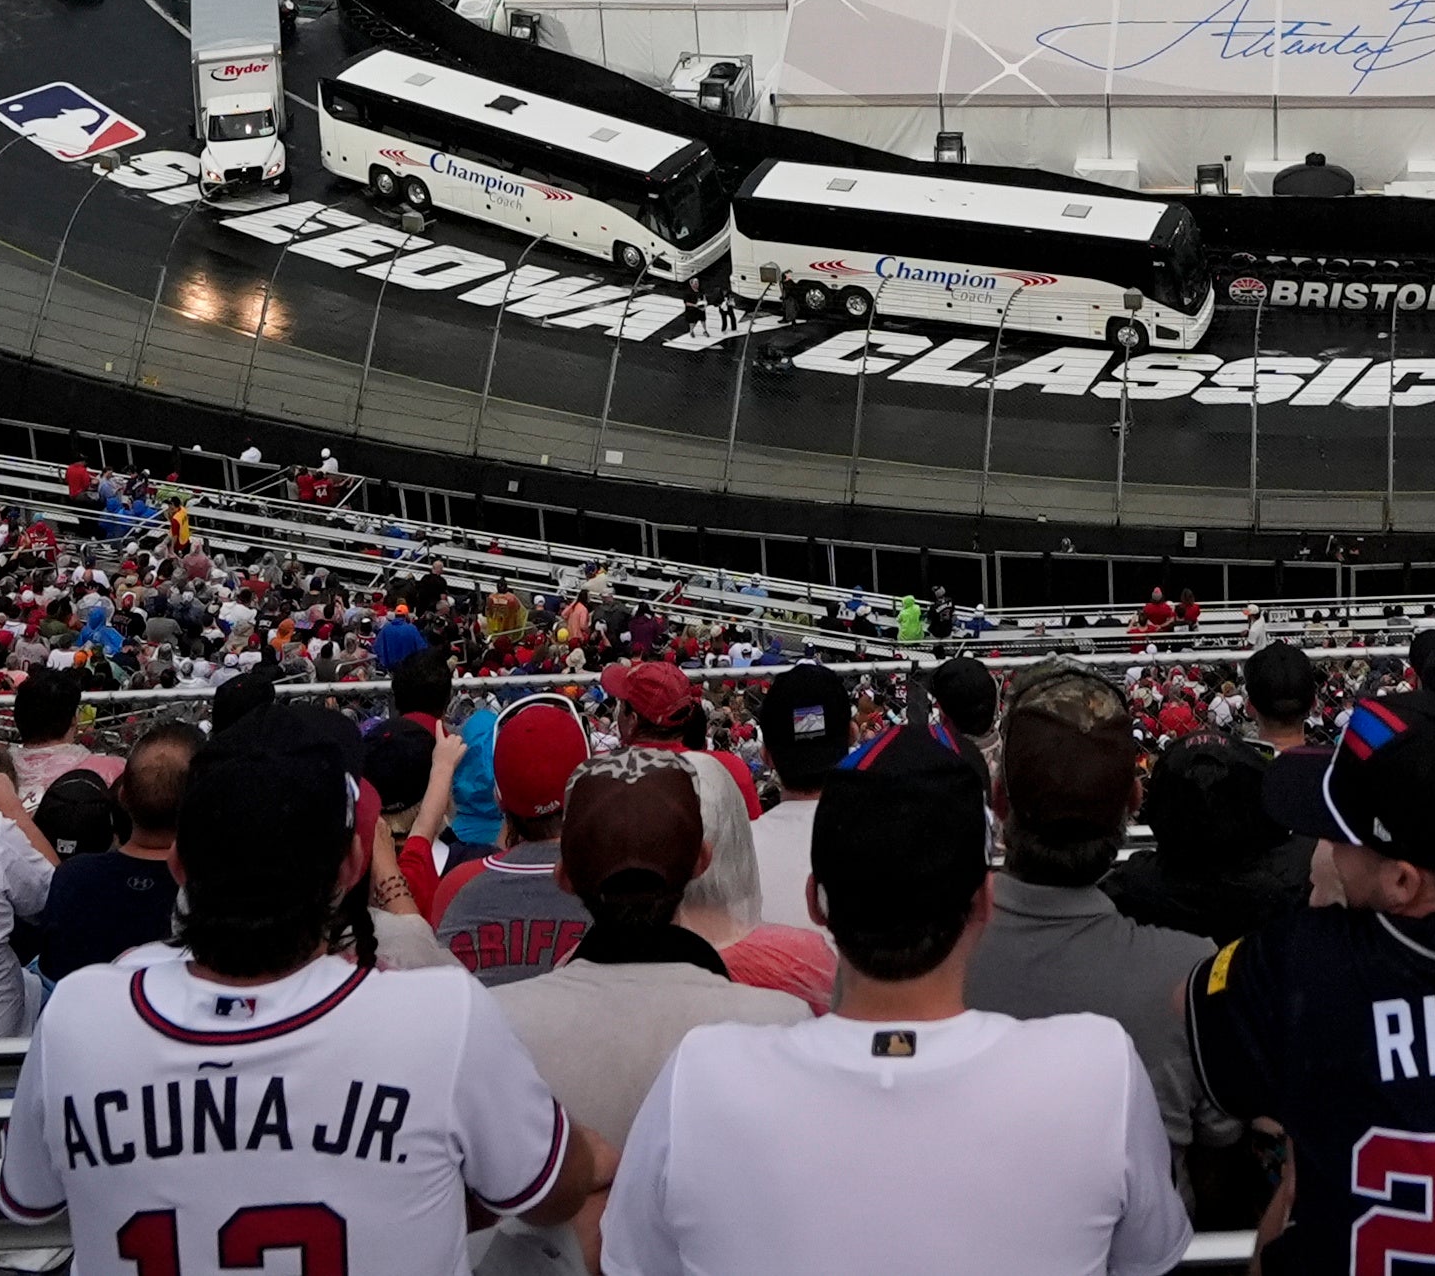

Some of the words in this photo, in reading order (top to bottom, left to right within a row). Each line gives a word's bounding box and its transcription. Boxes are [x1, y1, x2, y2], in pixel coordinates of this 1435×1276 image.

[224, 63, 270, 77] Ryder
[429, 152, 525, 198] Champion
[488, 191, 523, 212] Coach
[875, 256, 997, 290] Champion
[950, 287, 993, 305] Coach
[533, 799, 562, 816] Reds
[64, 1061, 294, 1170] ACUÑA
[311, 1080, 411, 1165] JR.
